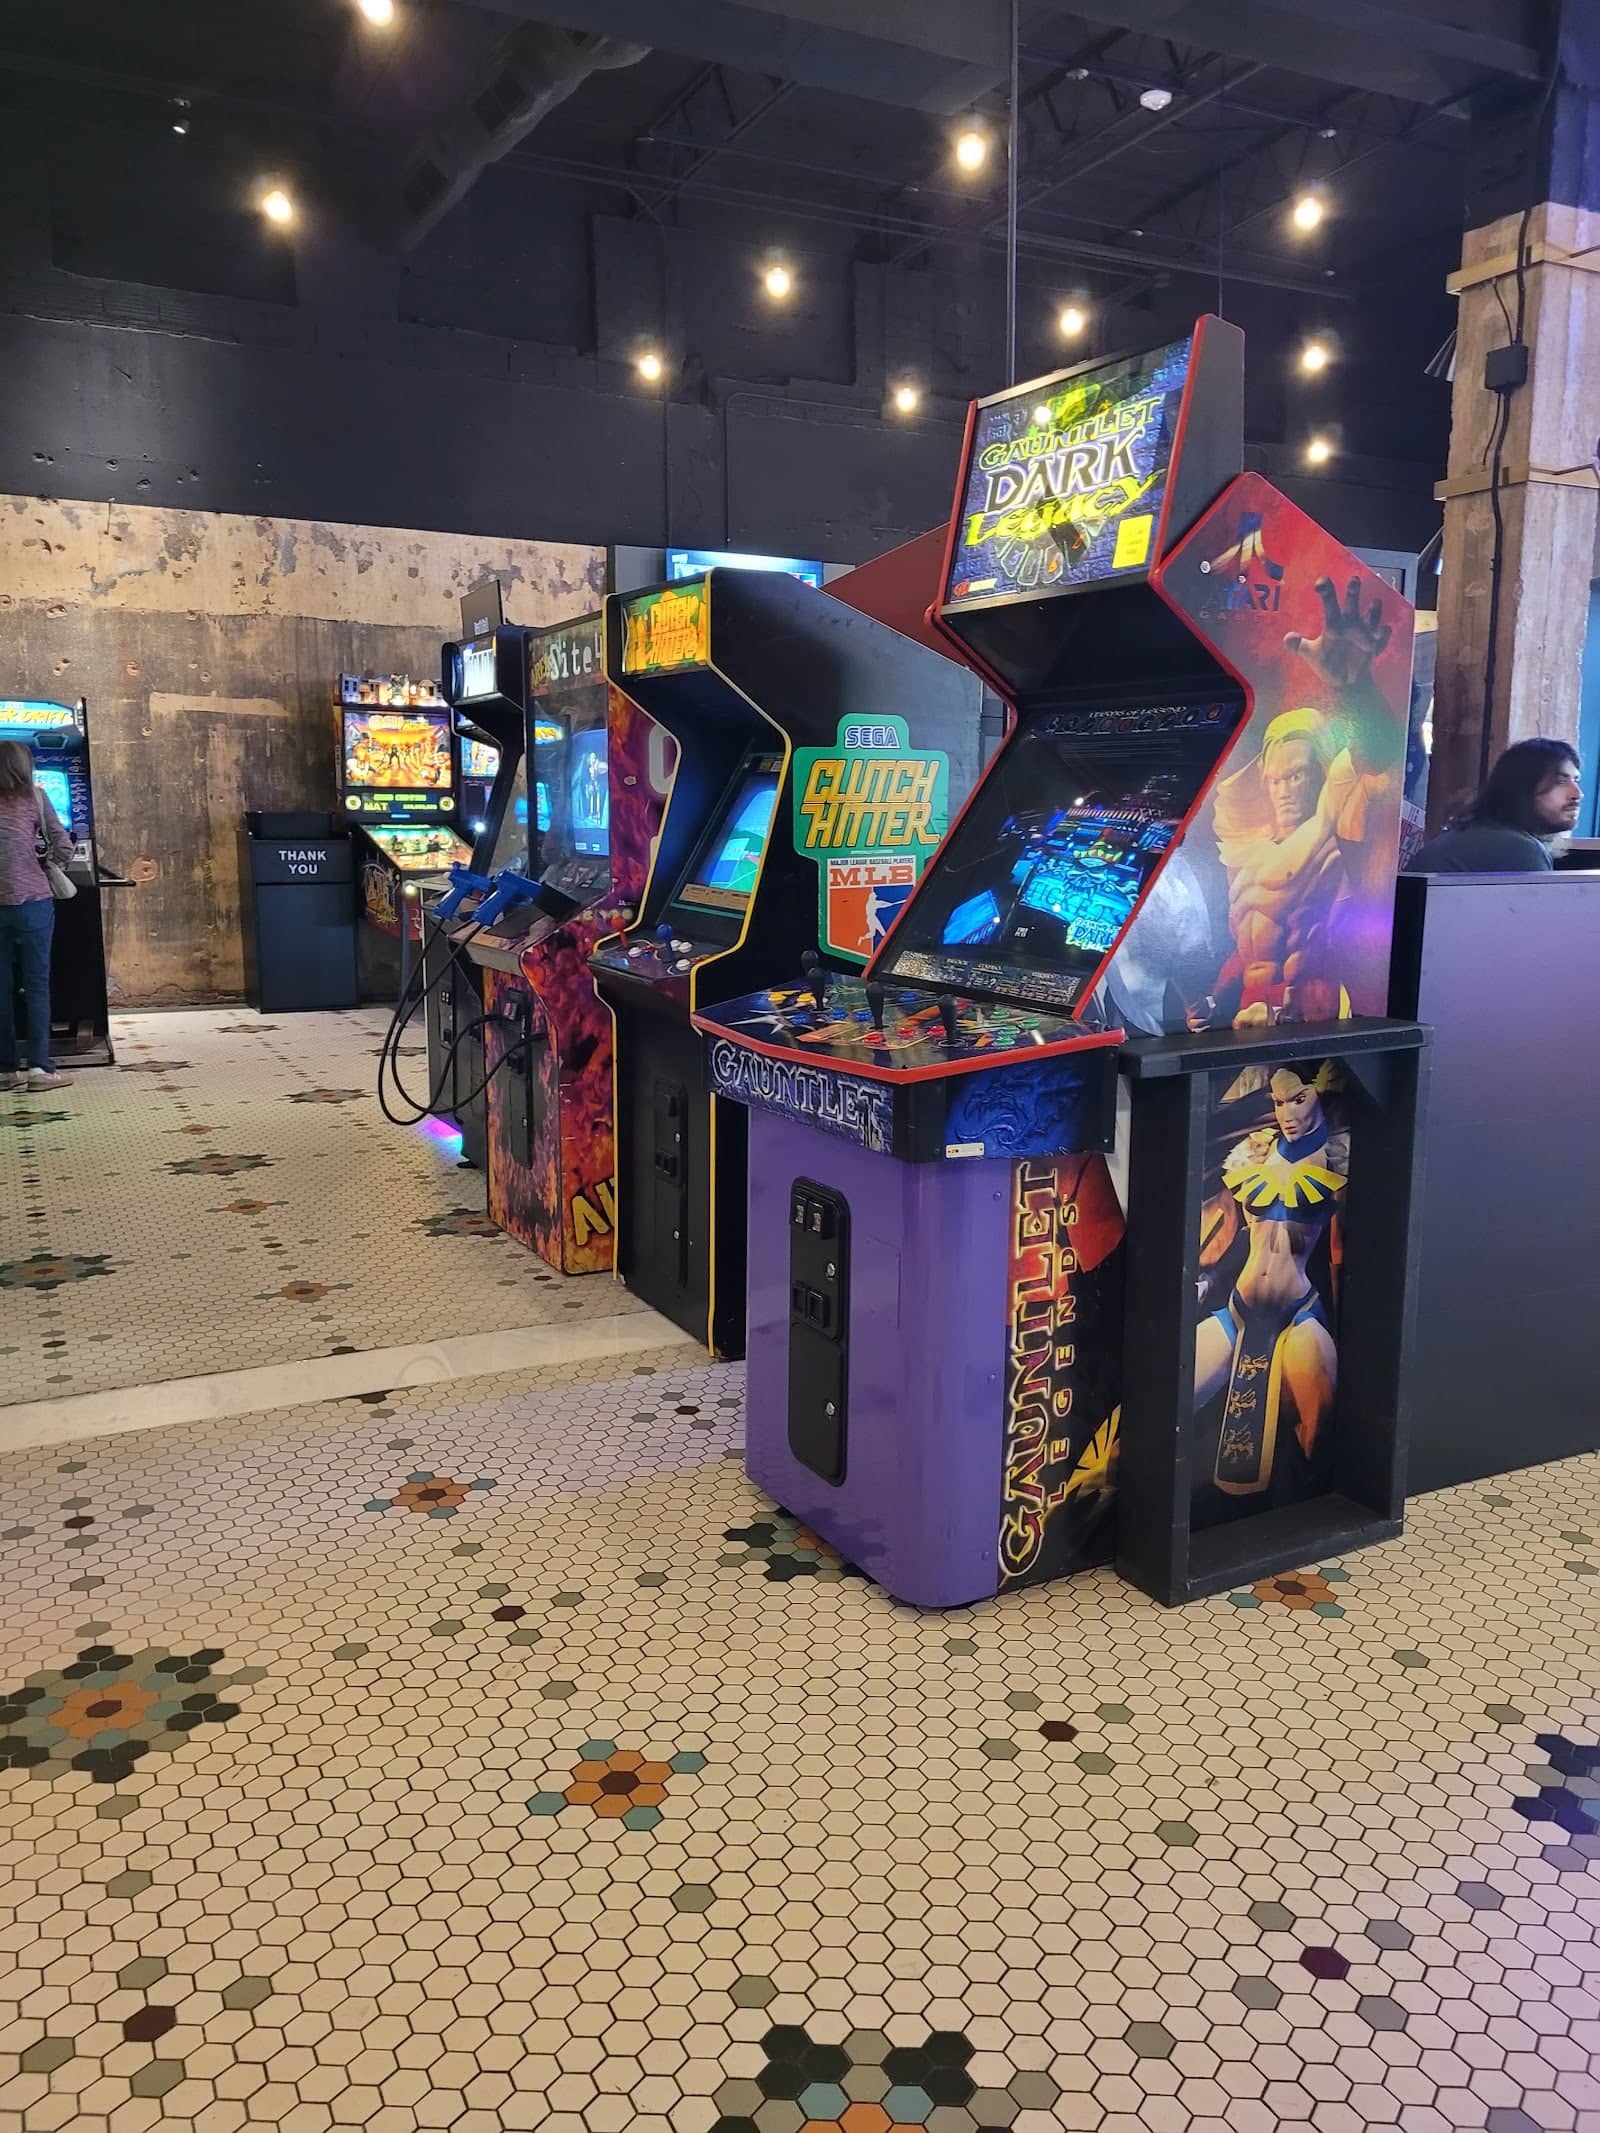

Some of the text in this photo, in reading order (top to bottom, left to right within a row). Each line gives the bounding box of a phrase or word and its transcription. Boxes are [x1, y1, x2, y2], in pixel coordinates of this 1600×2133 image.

[979, 394, 1163, 470] GAUNTLET
[984, 428, 1146, 513] DARK
[548, 640, 592, 680] Site
[844, 725, 900, 748] SEGA
[803, 759, 939, 804] CLUTCH
[800, 802, 941, 848] HITTER
[279, 850, 327, 861] THANK
[288, 864, 318, 875] YOU
[830, 865, 913, 887] MLB
[711, 1038, 886, 1148] GAUNTLET
[1000, 1161, 1058, 1577] GAUNTLET
